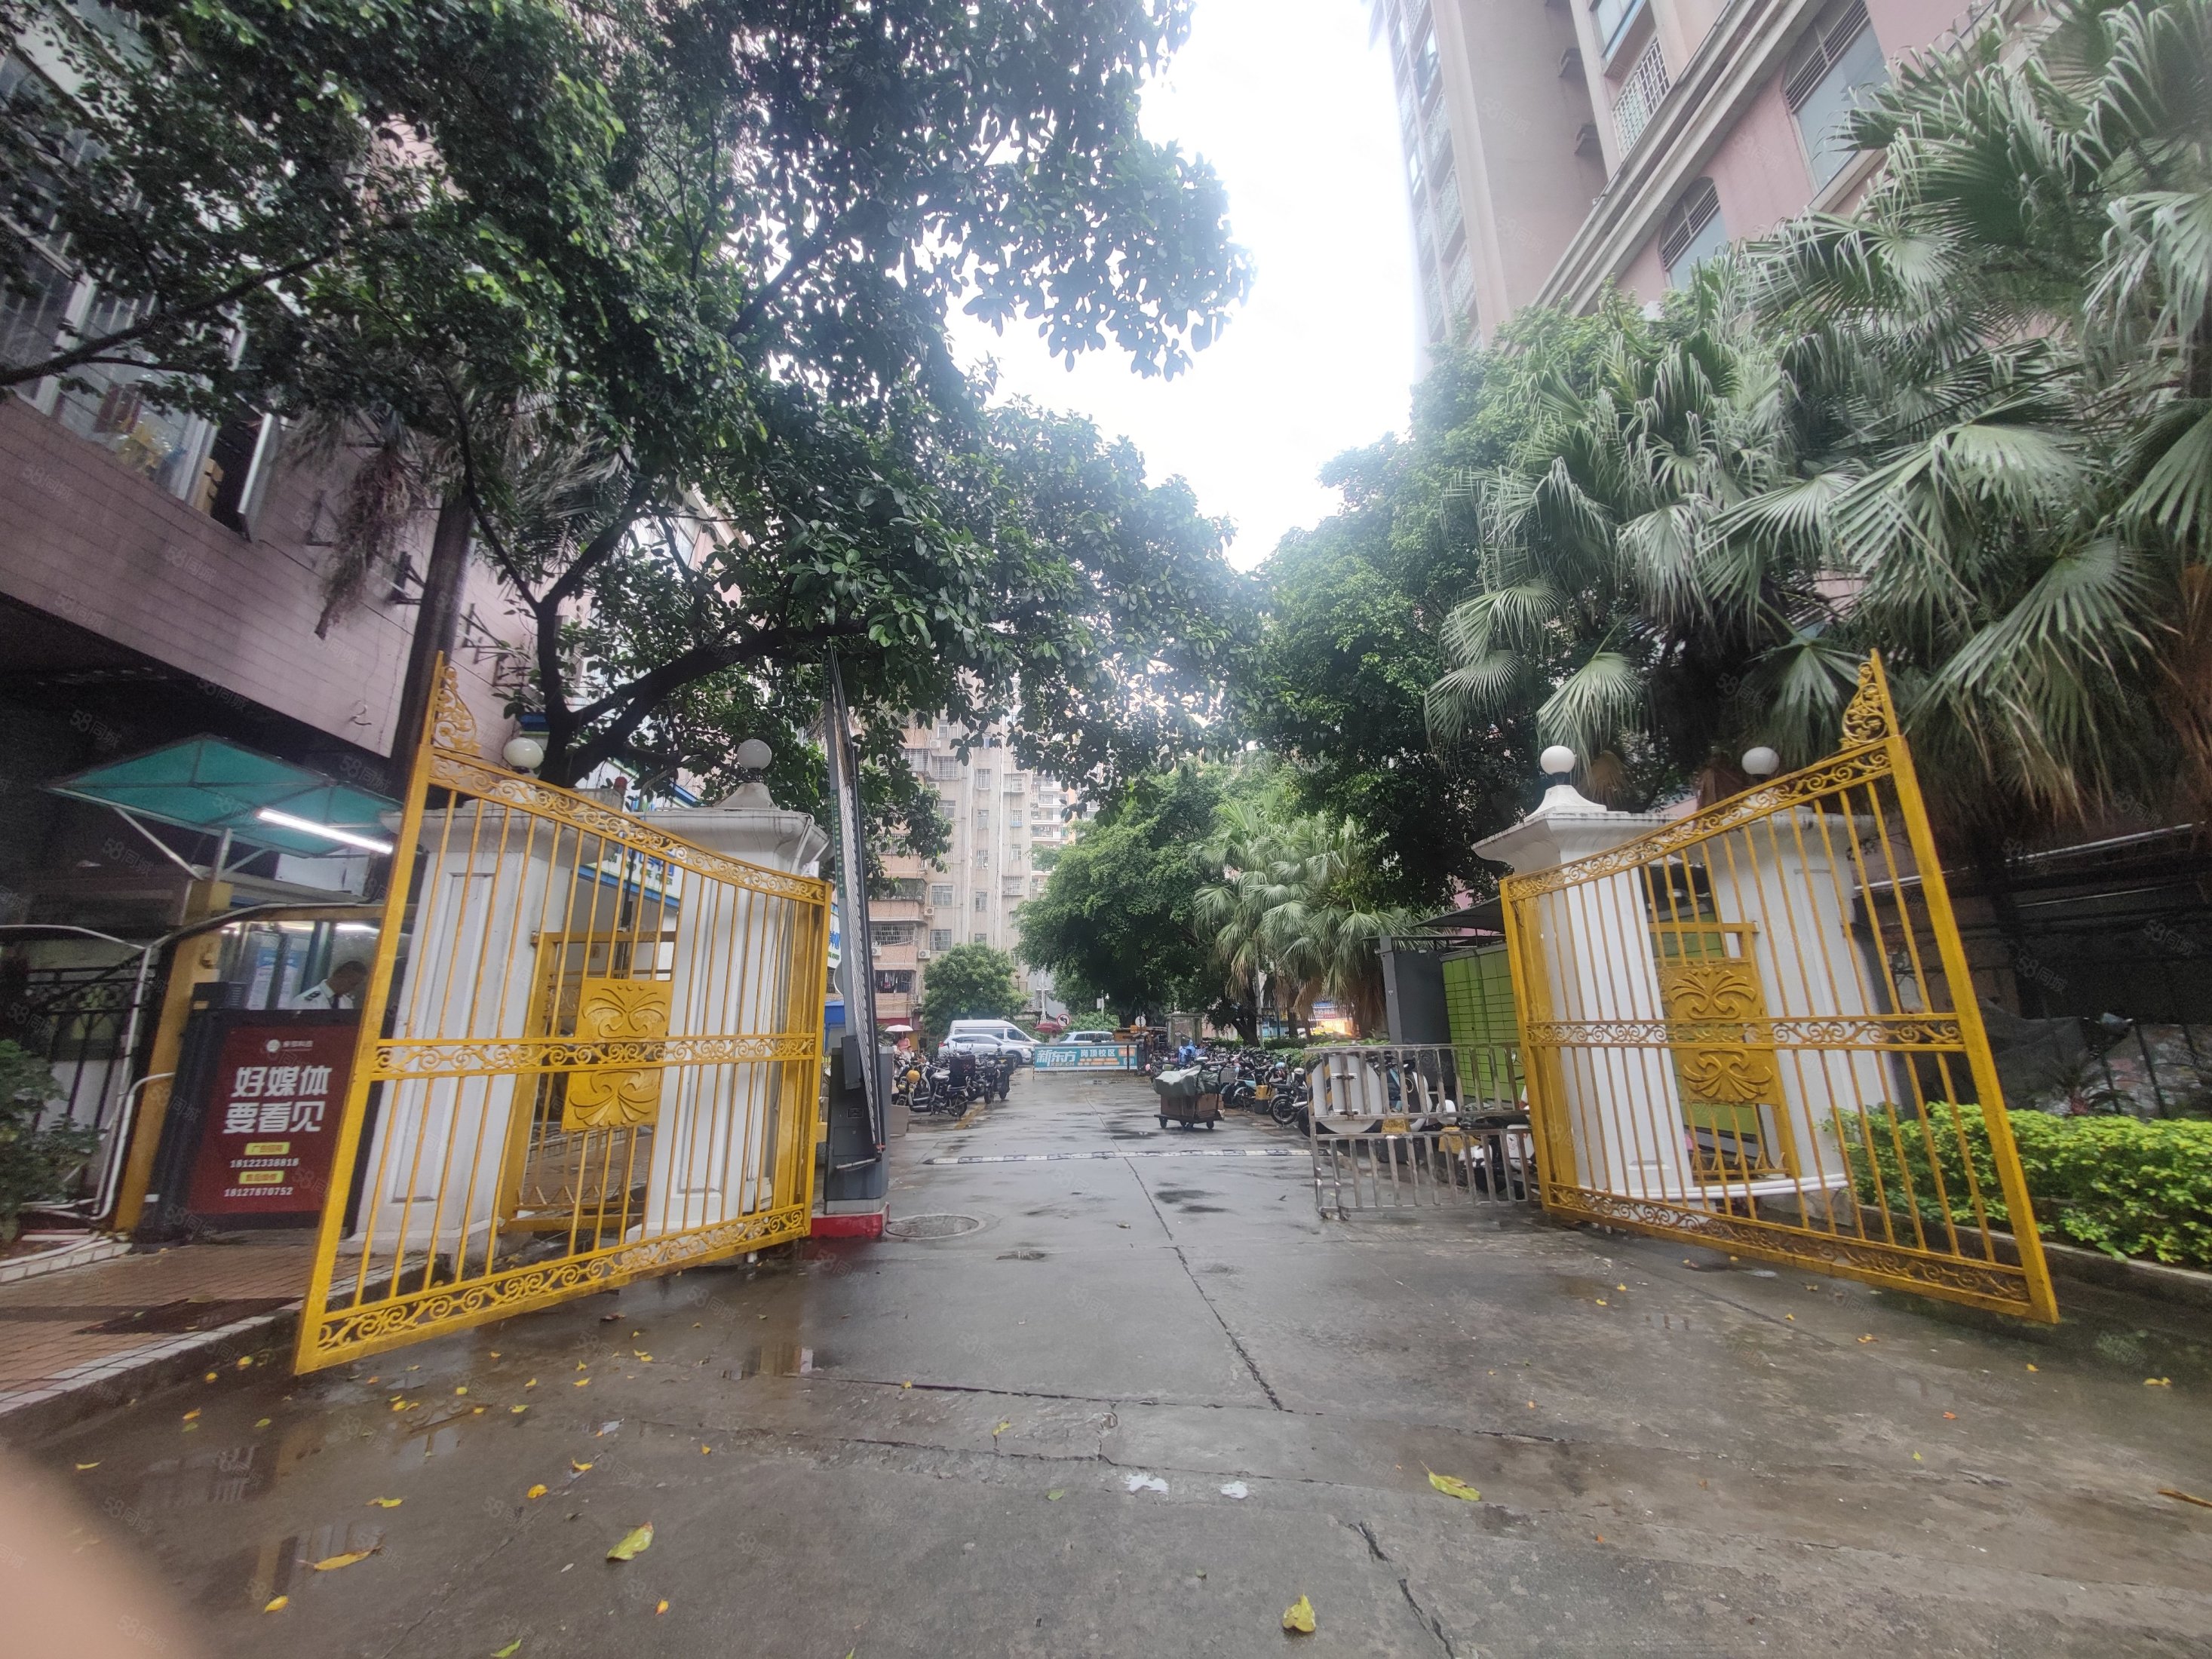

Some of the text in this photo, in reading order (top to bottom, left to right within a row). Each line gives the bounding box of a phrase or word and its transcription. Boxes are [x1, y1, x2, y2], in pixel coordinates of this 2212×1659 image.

[1036, 1050, 1077, 1066] 新东方
[1080, 1049, 1115, 1057] 岗顶校区
[231, 1066, 332, 1097] 好媒体
[223, 1101, 325, 1133] 要看见
